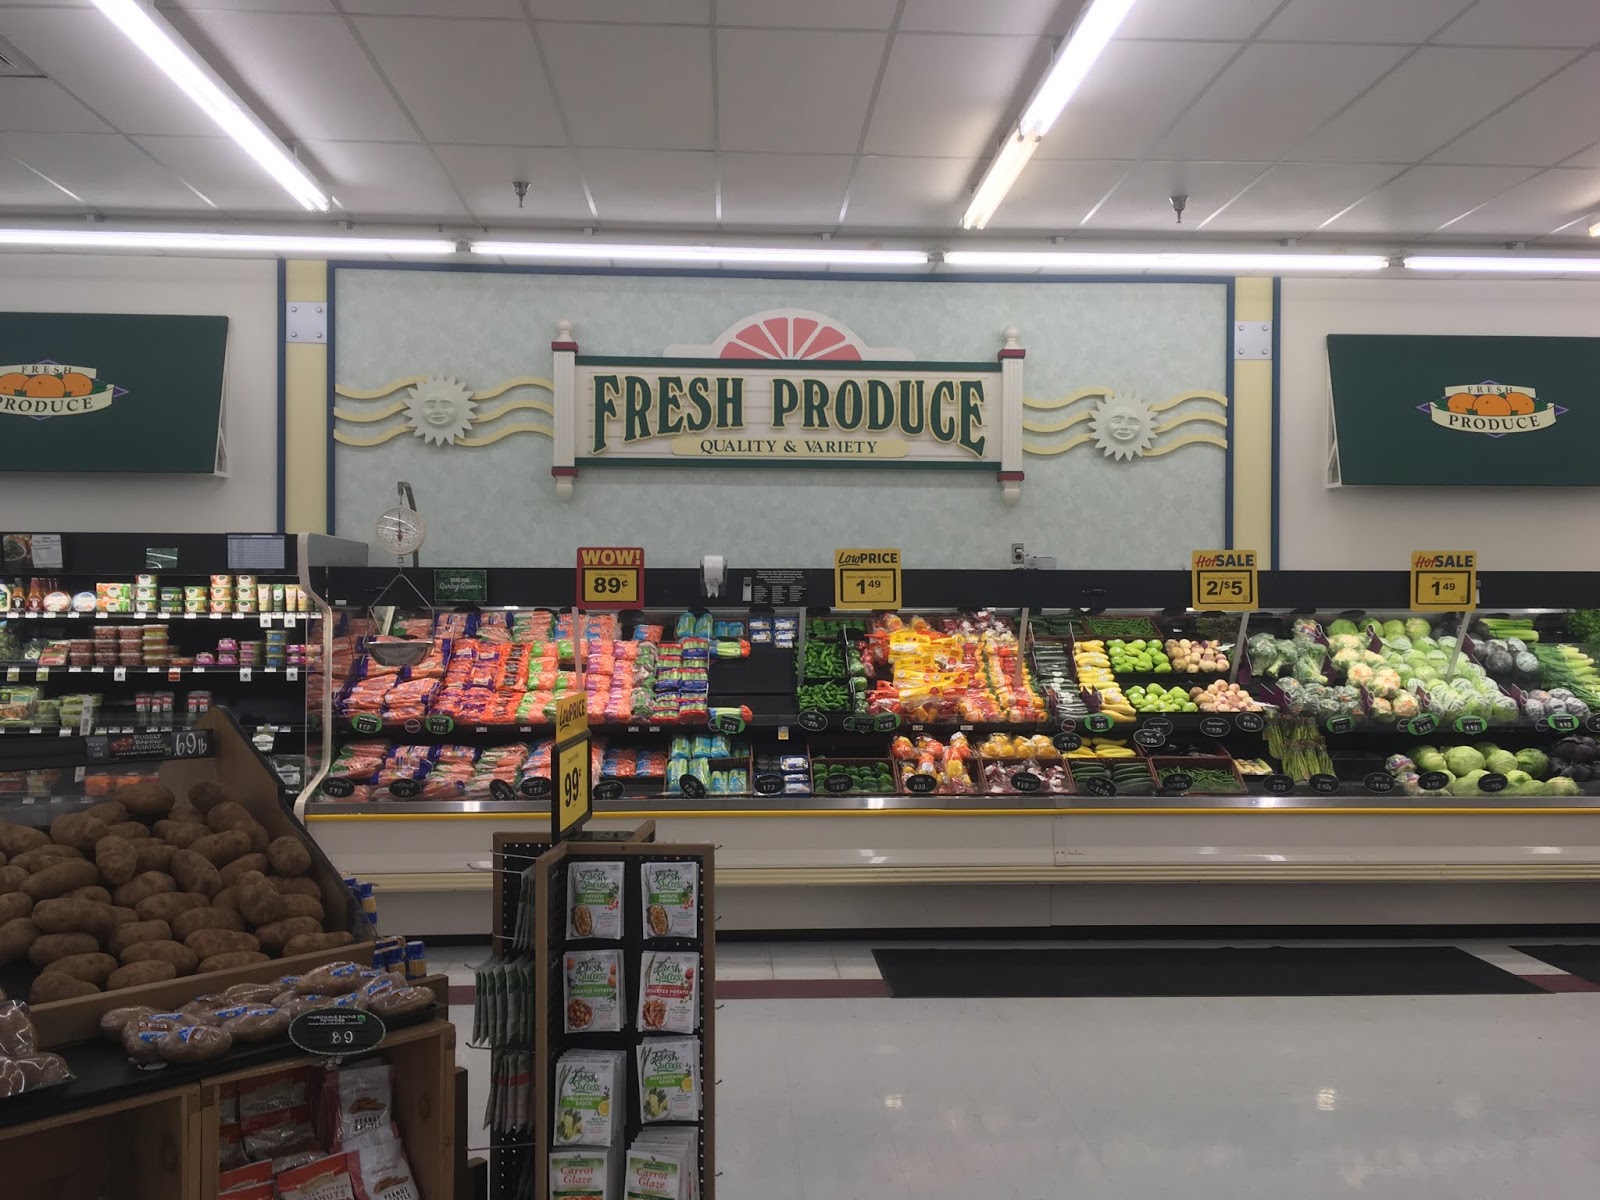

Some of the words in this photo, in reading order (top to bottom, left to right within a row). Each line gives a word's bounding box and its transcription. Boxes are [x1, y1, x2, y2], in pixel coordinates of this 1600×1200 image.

[21, 366, 72, 374] FRESH
[1467, 386, 1513, 394] FRESH
[592, 374, 744, 454] FRESH
[771, 377, 986, 459] PRODUCE
[1449, 414, 1541, 430] PRODUCE
[700, 439, 777, 454] QUALITY
[783, 441, 798, 453] &
[805, 440, 877, 454] VARIETY
[581, 549, 641, 566] WOW!
[653, 870, 682, 882] Fresh
[576, 960, 605, 974] Fresh
[653, 961, 683, 974] Fresh
[578, 971, 608, 981] Success
[656, 970, 684, 981] Success
[650, 1050, 679, 1064] Fresh
[654, 1061, 683, 1072] Success
[569, 1069, 599, 1084] Fresh
[572, 1080, 601, 1092] Success
[560, 1166, 594, 1175] Carrot
[636, 1167, 669, 1179] Carrot
[563, 1175, 592, 1184] Glaze
[638, 1177, 666, 1189] Glaze
